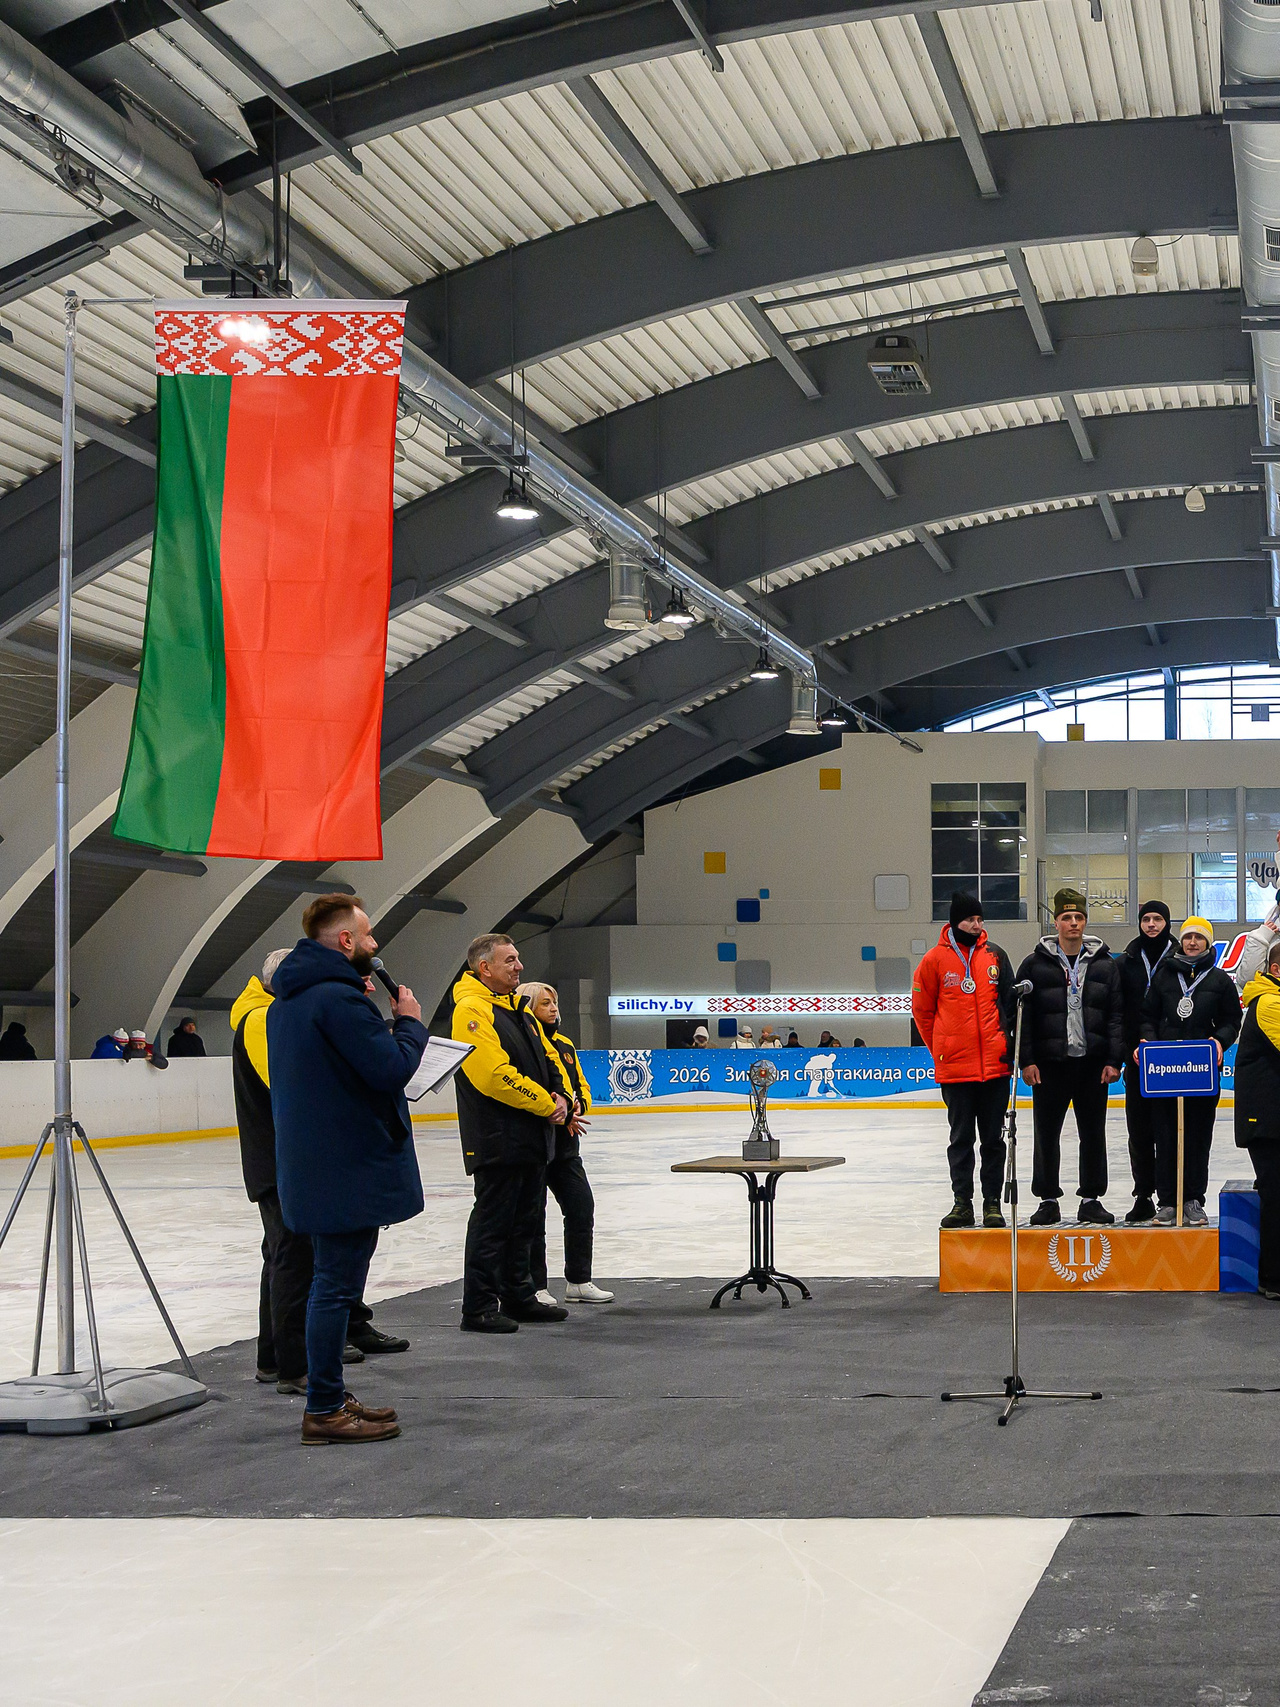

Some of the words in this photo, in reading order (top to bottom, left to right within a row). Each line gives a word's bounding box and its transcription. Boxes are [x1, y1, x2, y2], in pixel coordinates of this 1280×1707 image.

[617, 998, 694, 1013] silichy.by
[669, 1066, 711, 1083] 2026
[793, 1067, 902, 1084] спартакиада
[906, 1067, 935, 1084] сре
[1147, 1060, 1210, 1077] Агрохолдинг
[501, 1074, 539, 1101] BELARUS
[1064, 1235, 1095, 1266] II
